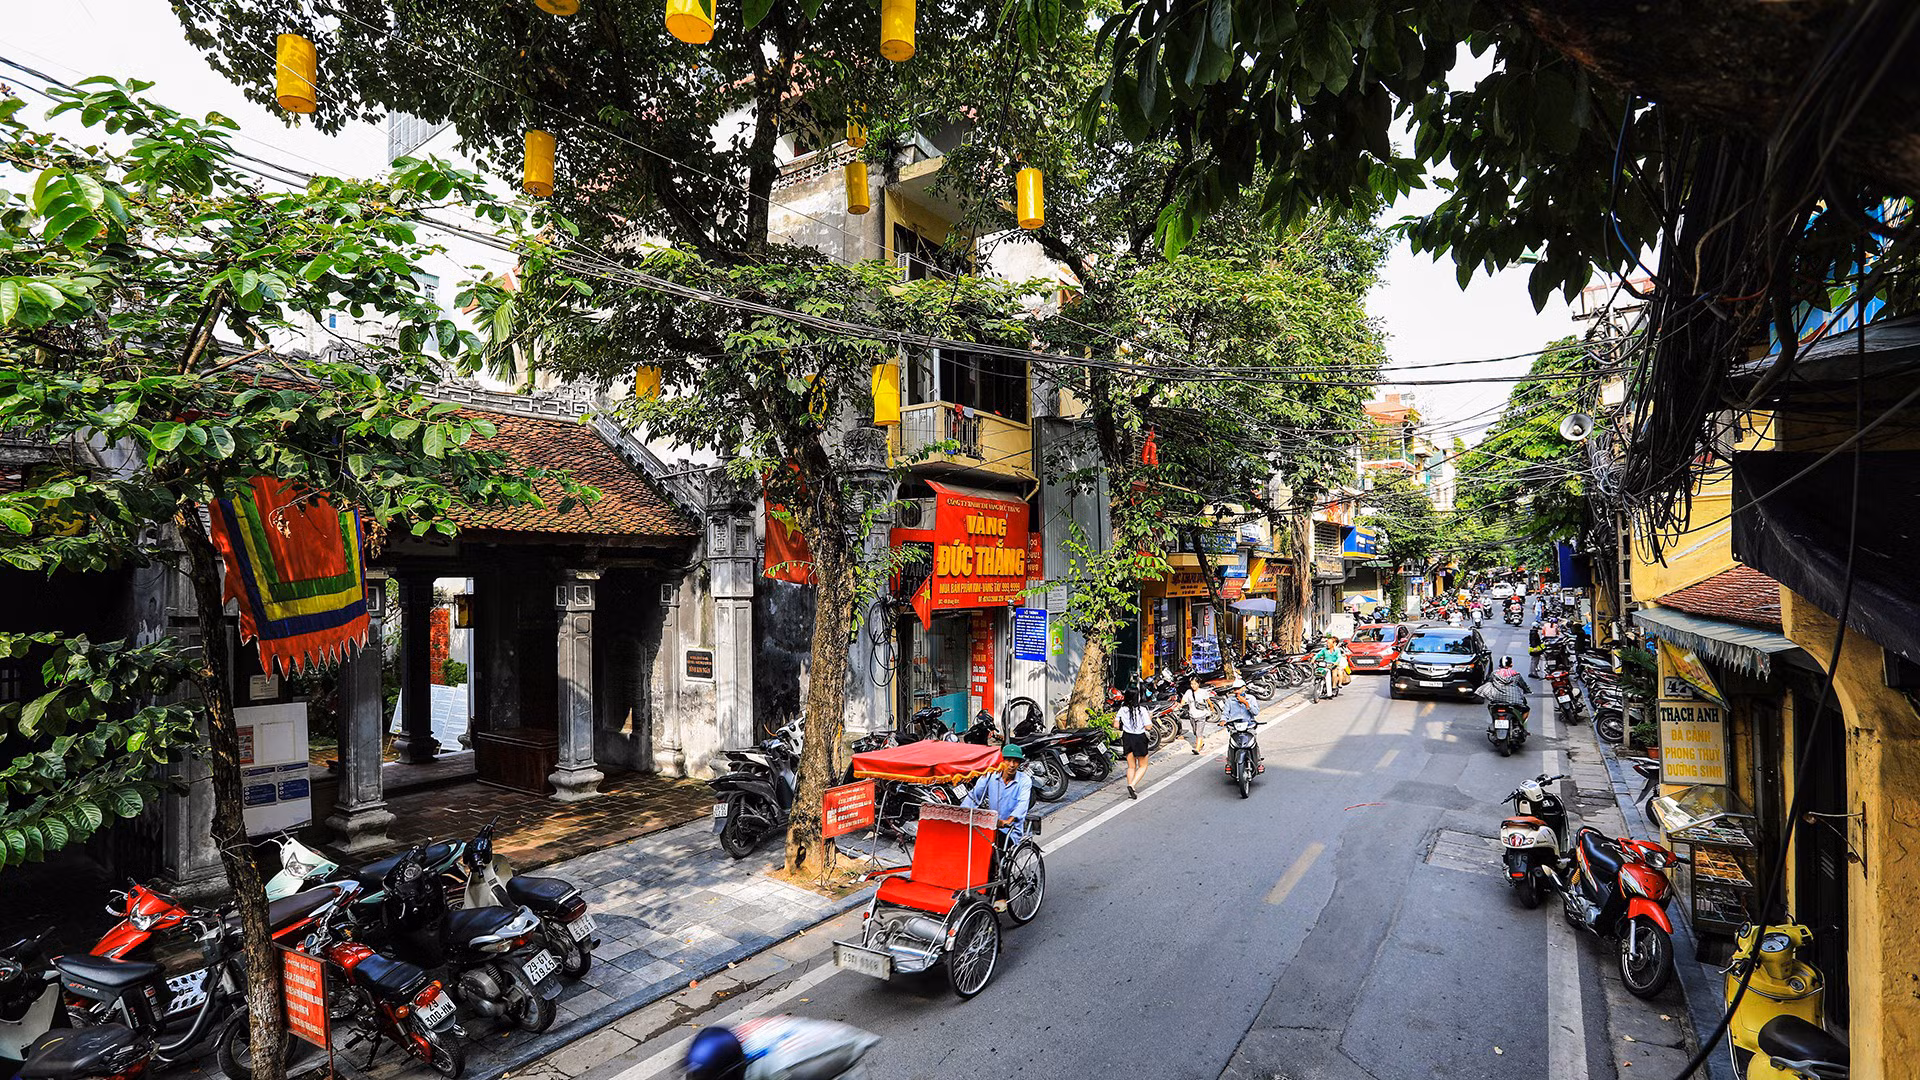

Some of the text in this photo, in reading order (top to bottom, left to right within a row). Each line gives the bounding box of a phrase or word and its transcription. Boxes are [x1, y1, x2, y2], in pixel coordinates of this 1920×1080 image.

[966, 511, 1007, 537] VÀNG
[937, 539, 973, 577] ĐỨC
[975, 540, 1025, 577] THẮNG
[951, 581, 960, 593] BÁN
[1660, 707, 1720, 725] THẠCH ANH
[1671, 725, 1712, 742] ĐÁ CẢNH
[1665, 747, 1696, 760] PHONG
[1700, 765, 1723, 778] SINH
[575, 922, 594, 938] 5591
